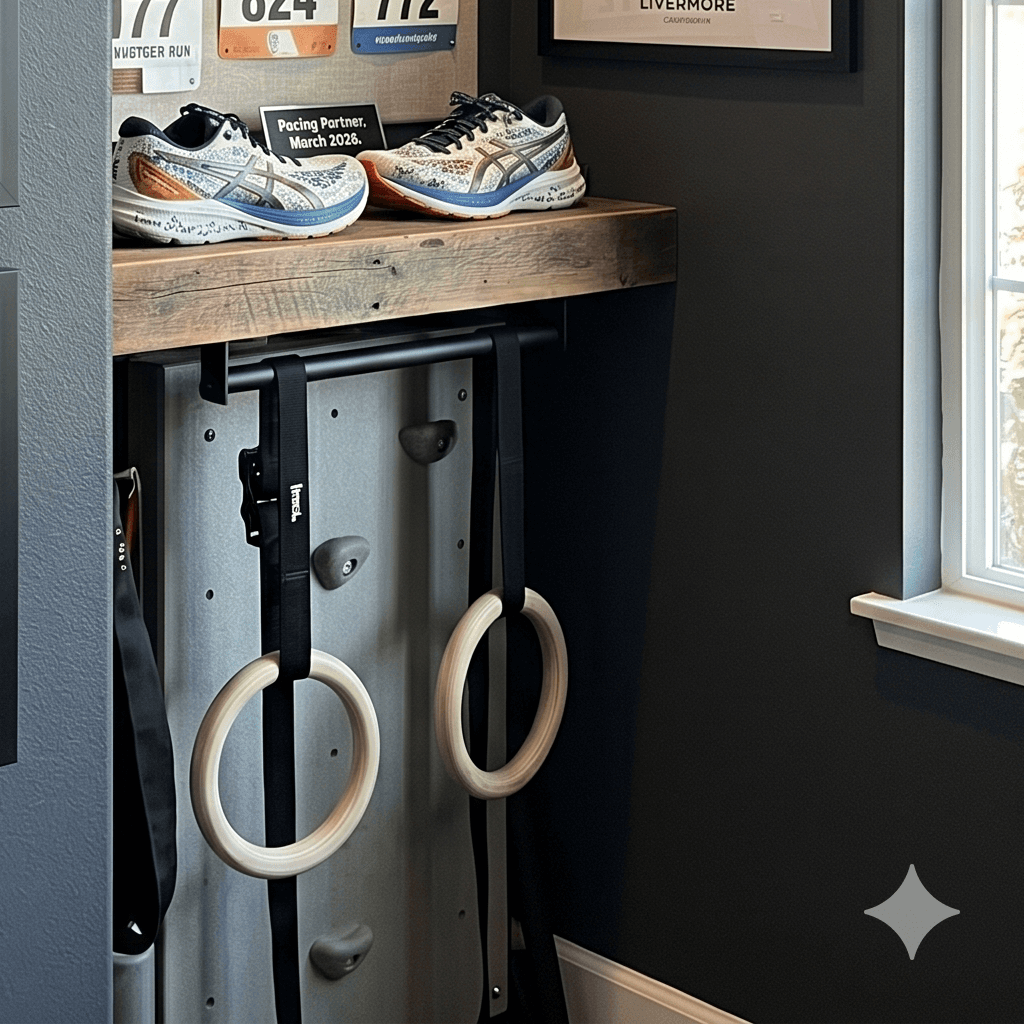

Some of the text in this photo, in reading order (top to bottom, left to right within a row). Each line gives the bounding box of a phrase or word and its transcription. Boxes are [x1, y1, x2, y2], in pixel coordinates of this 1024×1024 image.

[169, 44, 191, 58] RUN
[277, 117, 319, 133] Pacing
[288, 134, 327, 149] March
